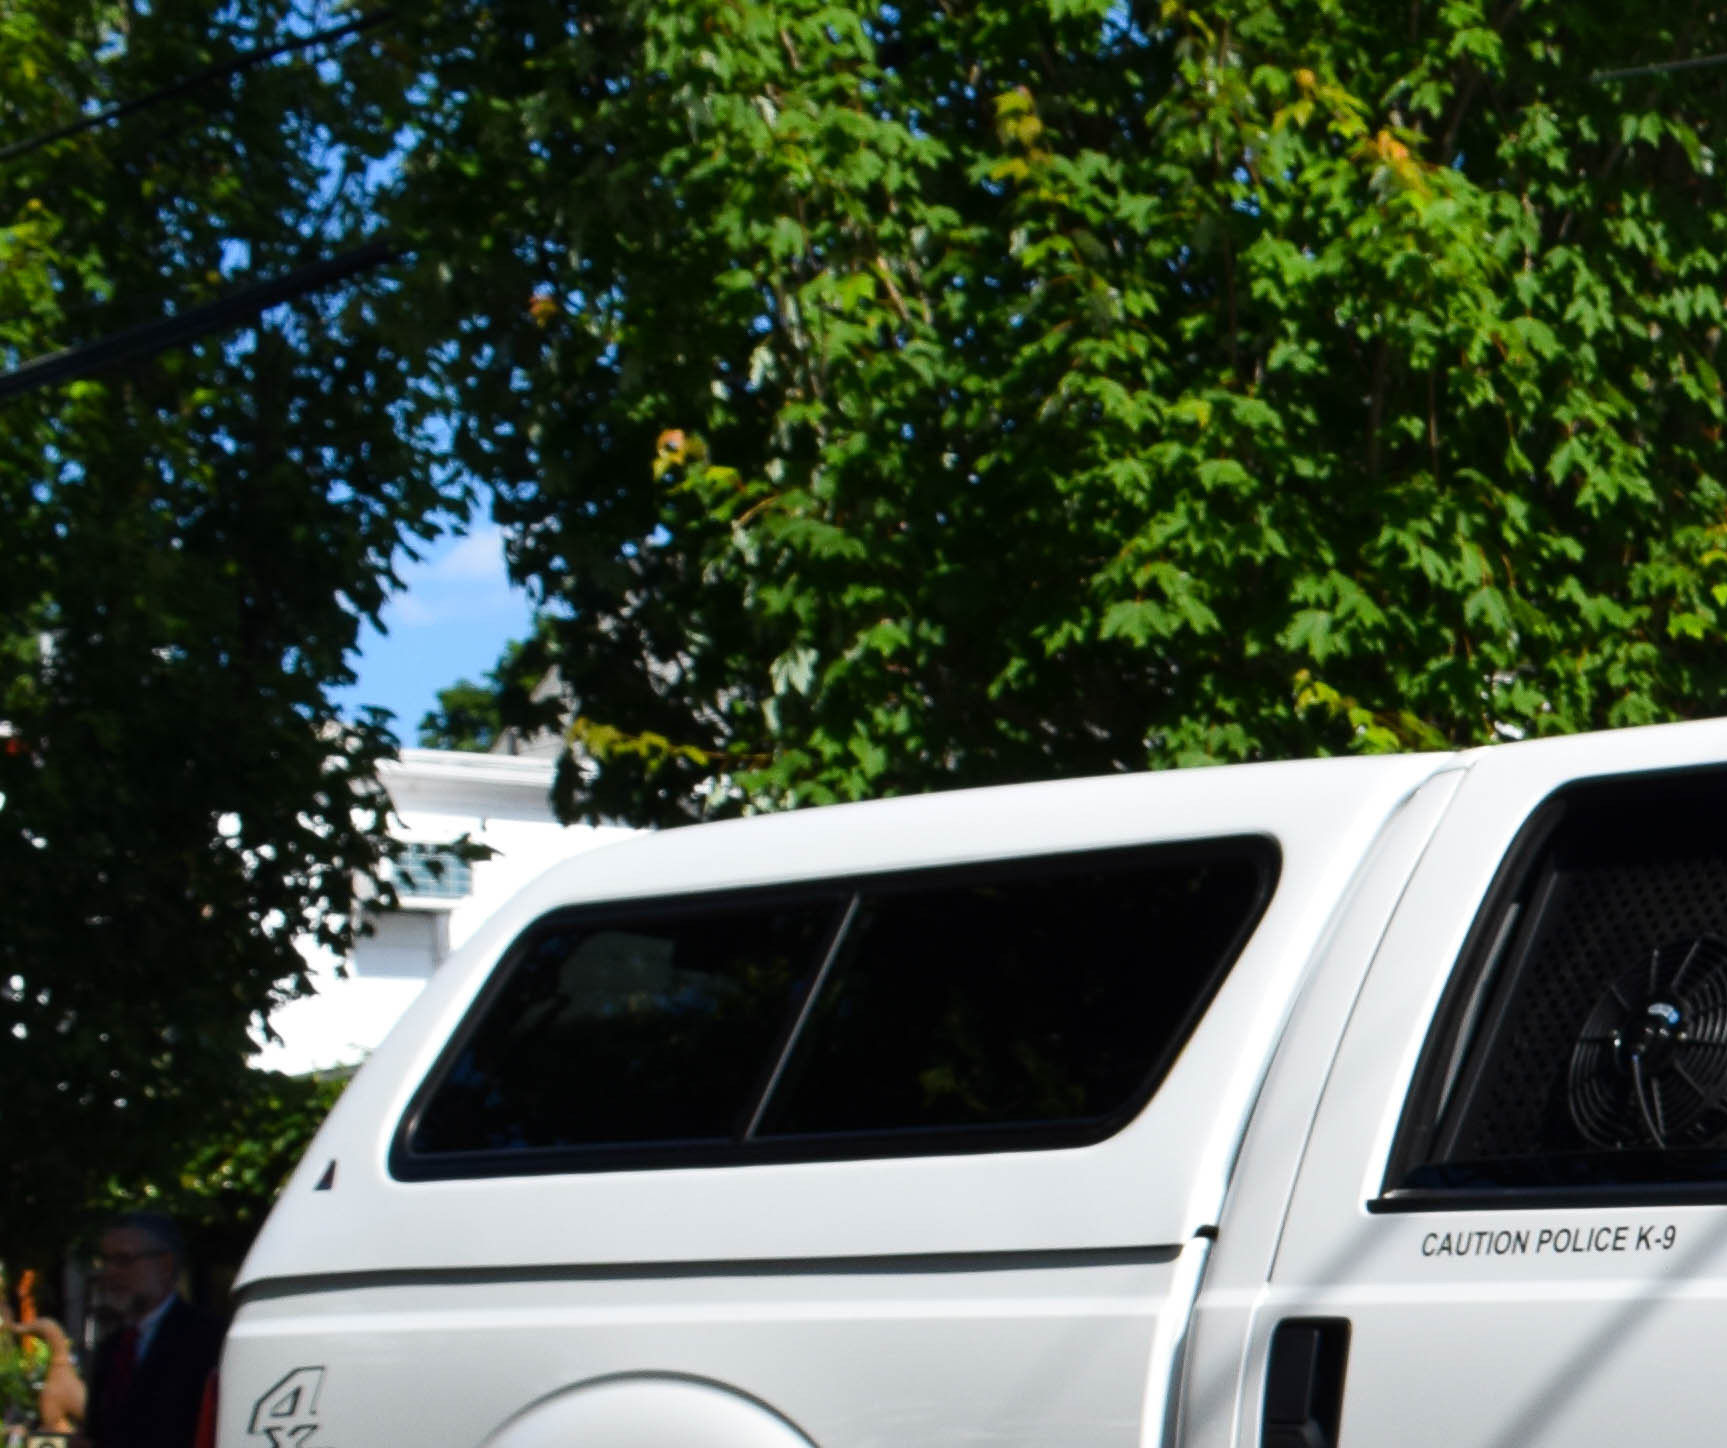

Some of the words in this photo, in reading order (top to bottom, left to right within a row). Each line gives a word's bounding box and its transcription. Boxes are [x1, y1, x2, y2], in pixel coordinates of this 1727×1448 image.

[1421, 1229, 1531, 1257] CAUTION
[1535, 1226, 1630, 1254] POLICE
[1634, 1224, 1677, 1251] K-9
